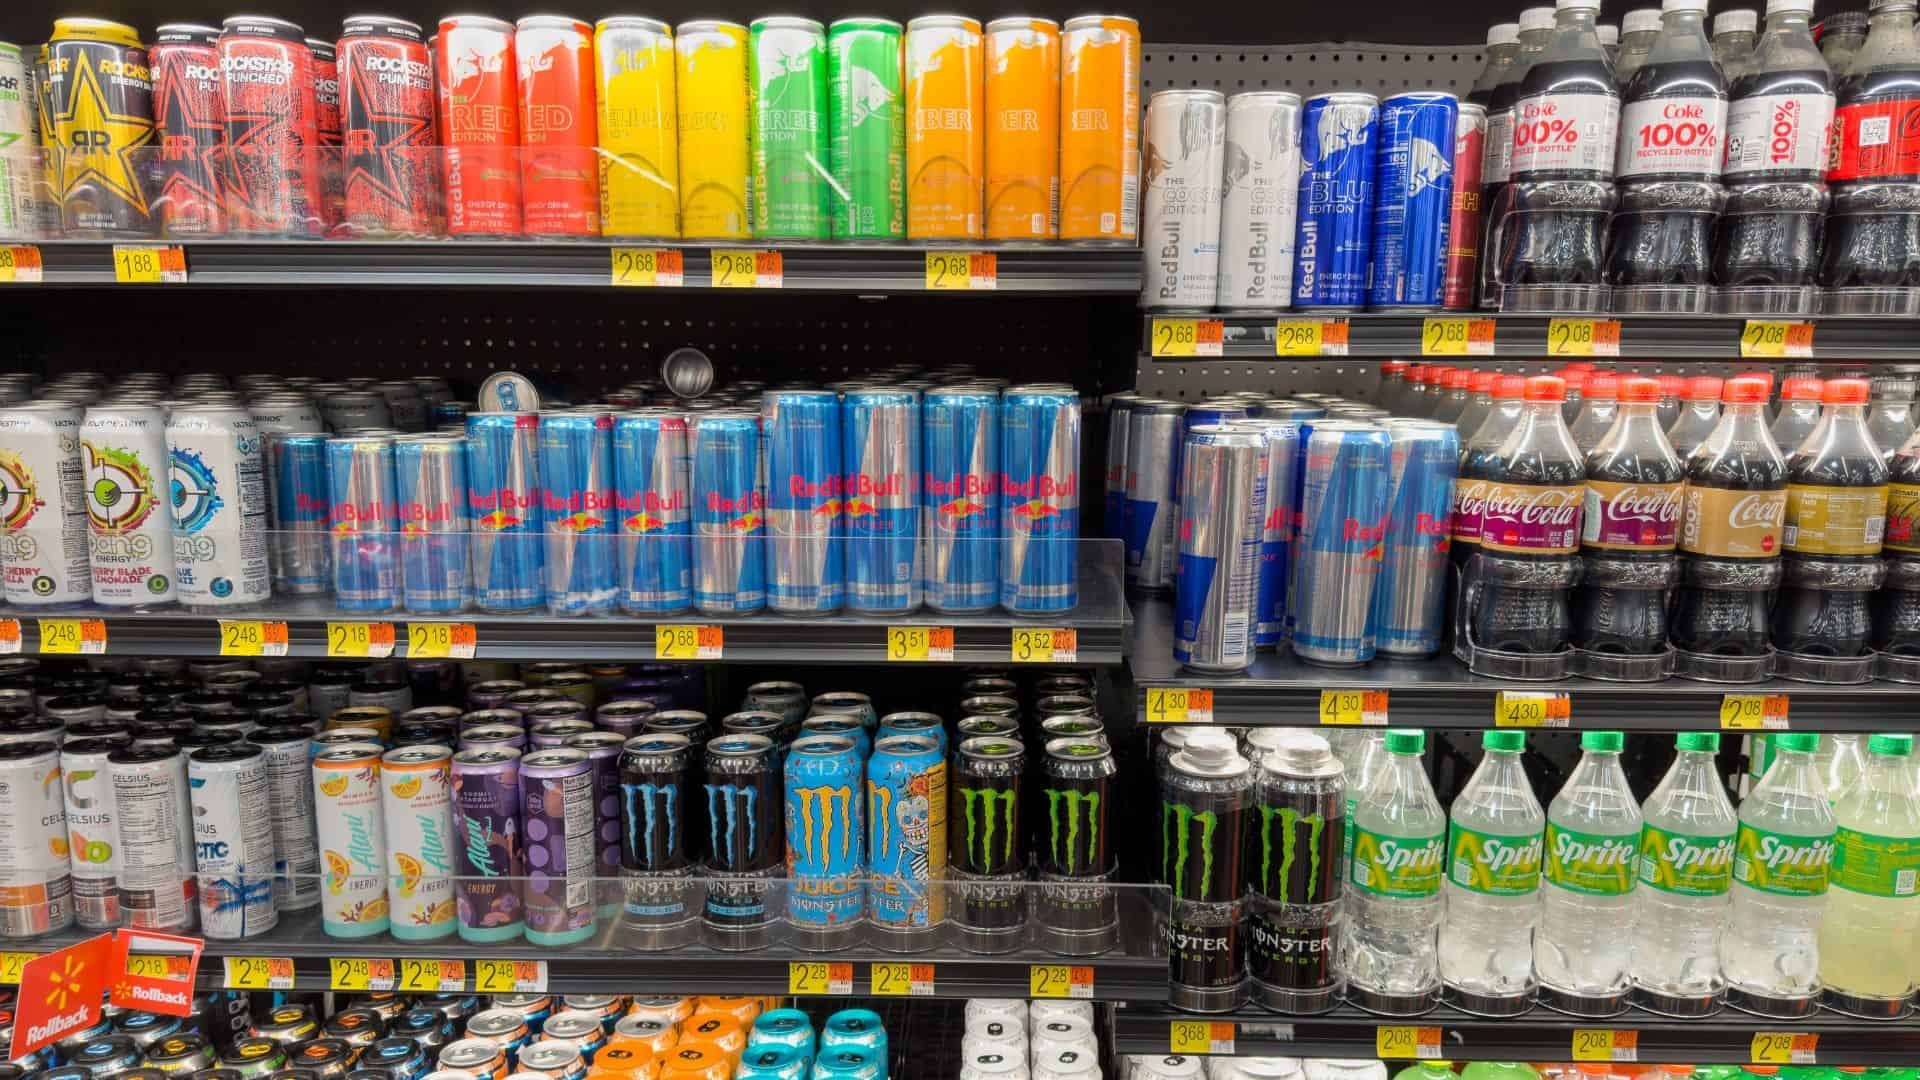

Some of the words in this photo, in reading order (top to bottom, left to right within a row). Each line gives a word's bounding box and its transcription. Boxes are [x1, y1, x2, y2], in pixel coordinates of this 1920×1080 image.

[1663, 103, 1704, 120] Coke
[1639, 122, 1718, 148] 100%
[1771, 101, 1795, 165] 100%
[1309, 203, 1354, 214] EDITION
[112, 774, 151, 783] CELSIUS
[1553, 832, 1634, 865] Sprite
[132, 986, 187, 1006] Rollback
[25, 1004, 89, 1047] Rollback
